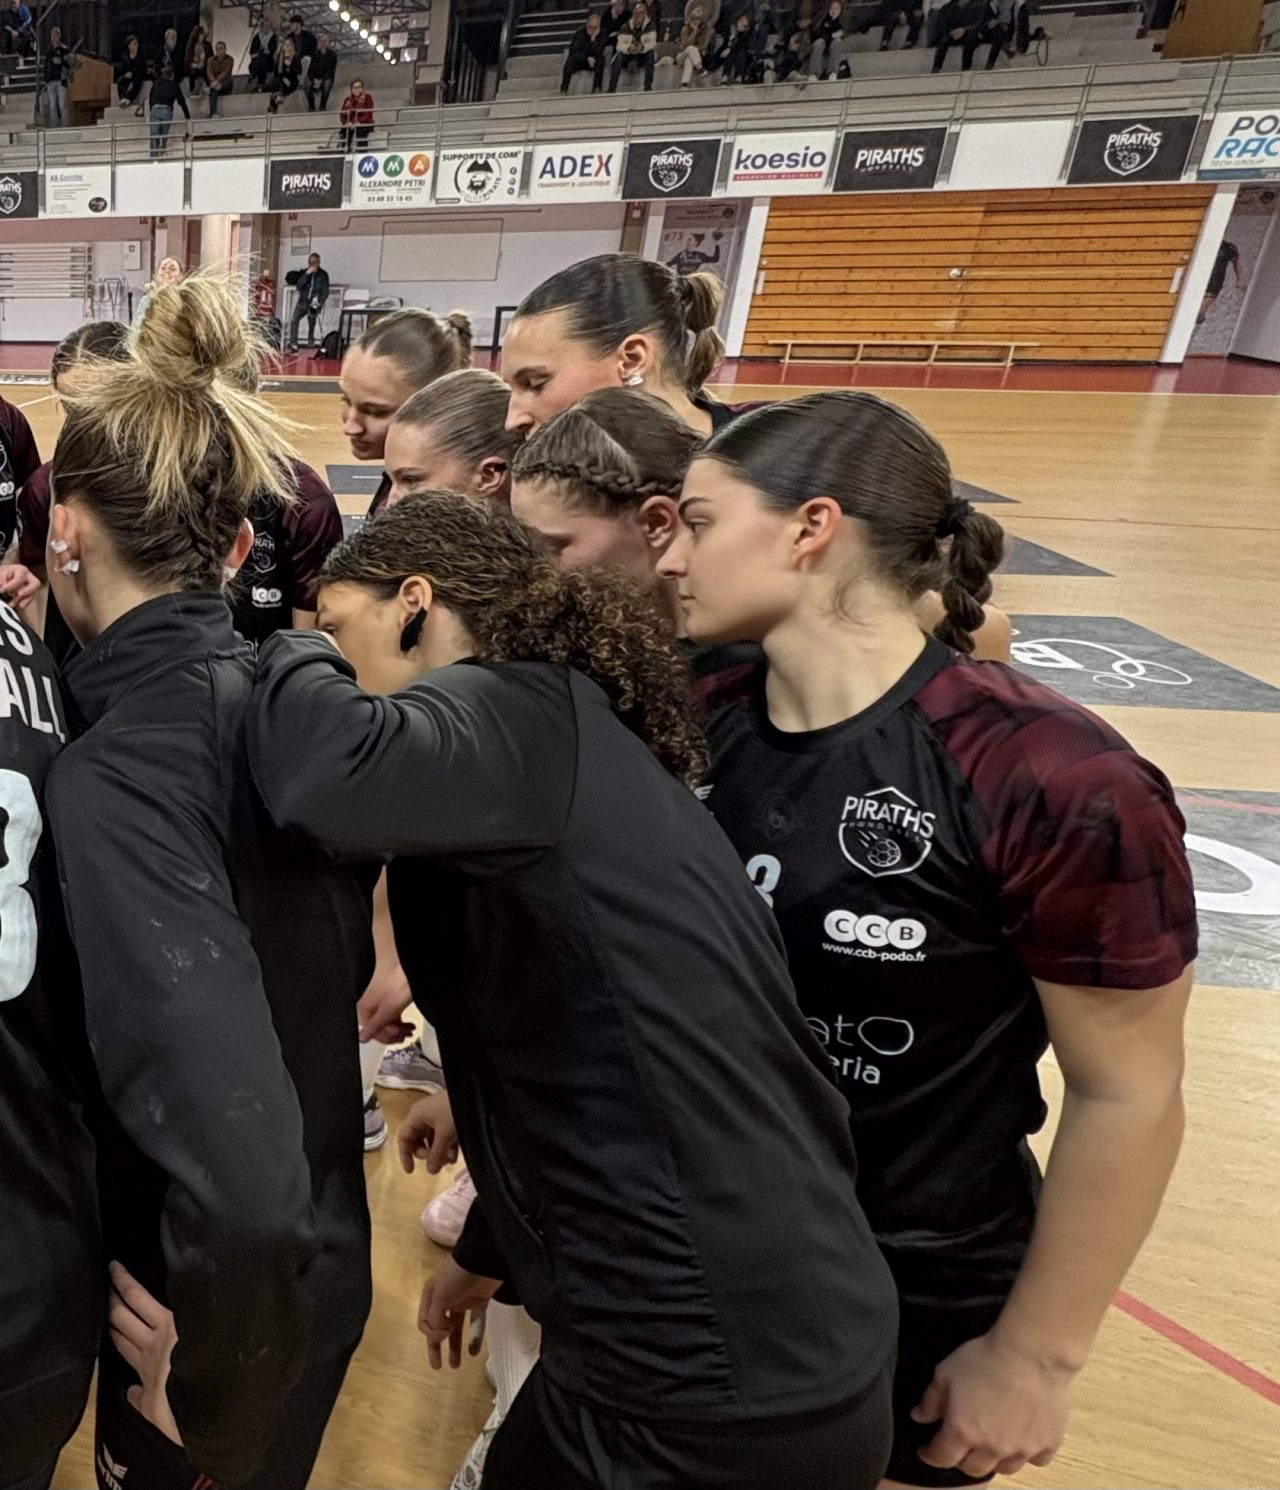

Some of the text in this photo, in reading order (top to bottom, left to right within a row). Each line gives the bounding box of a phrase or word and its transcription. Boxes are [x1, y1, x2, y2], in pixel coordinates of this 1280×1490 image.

[1227, 114, 1280, 136] PO
[1105, 132, 1163, 149] PIRATHS
[442, 152, 485, 161] SUPPORTS
[539, 154, 614, 179] ADEX
[649, 153, 694, 168] PIRATHS
[734, 146, 827, 171] koesio
[854, 147, 925, 170] PIRATHS
[281, 173, 332, 192] PIRATHS
[841, 795, 936, 839] PIRATHS
[830, 914, 919, 944] CCB
[821, 941, 927, 962] www.ccb-podo.fr
